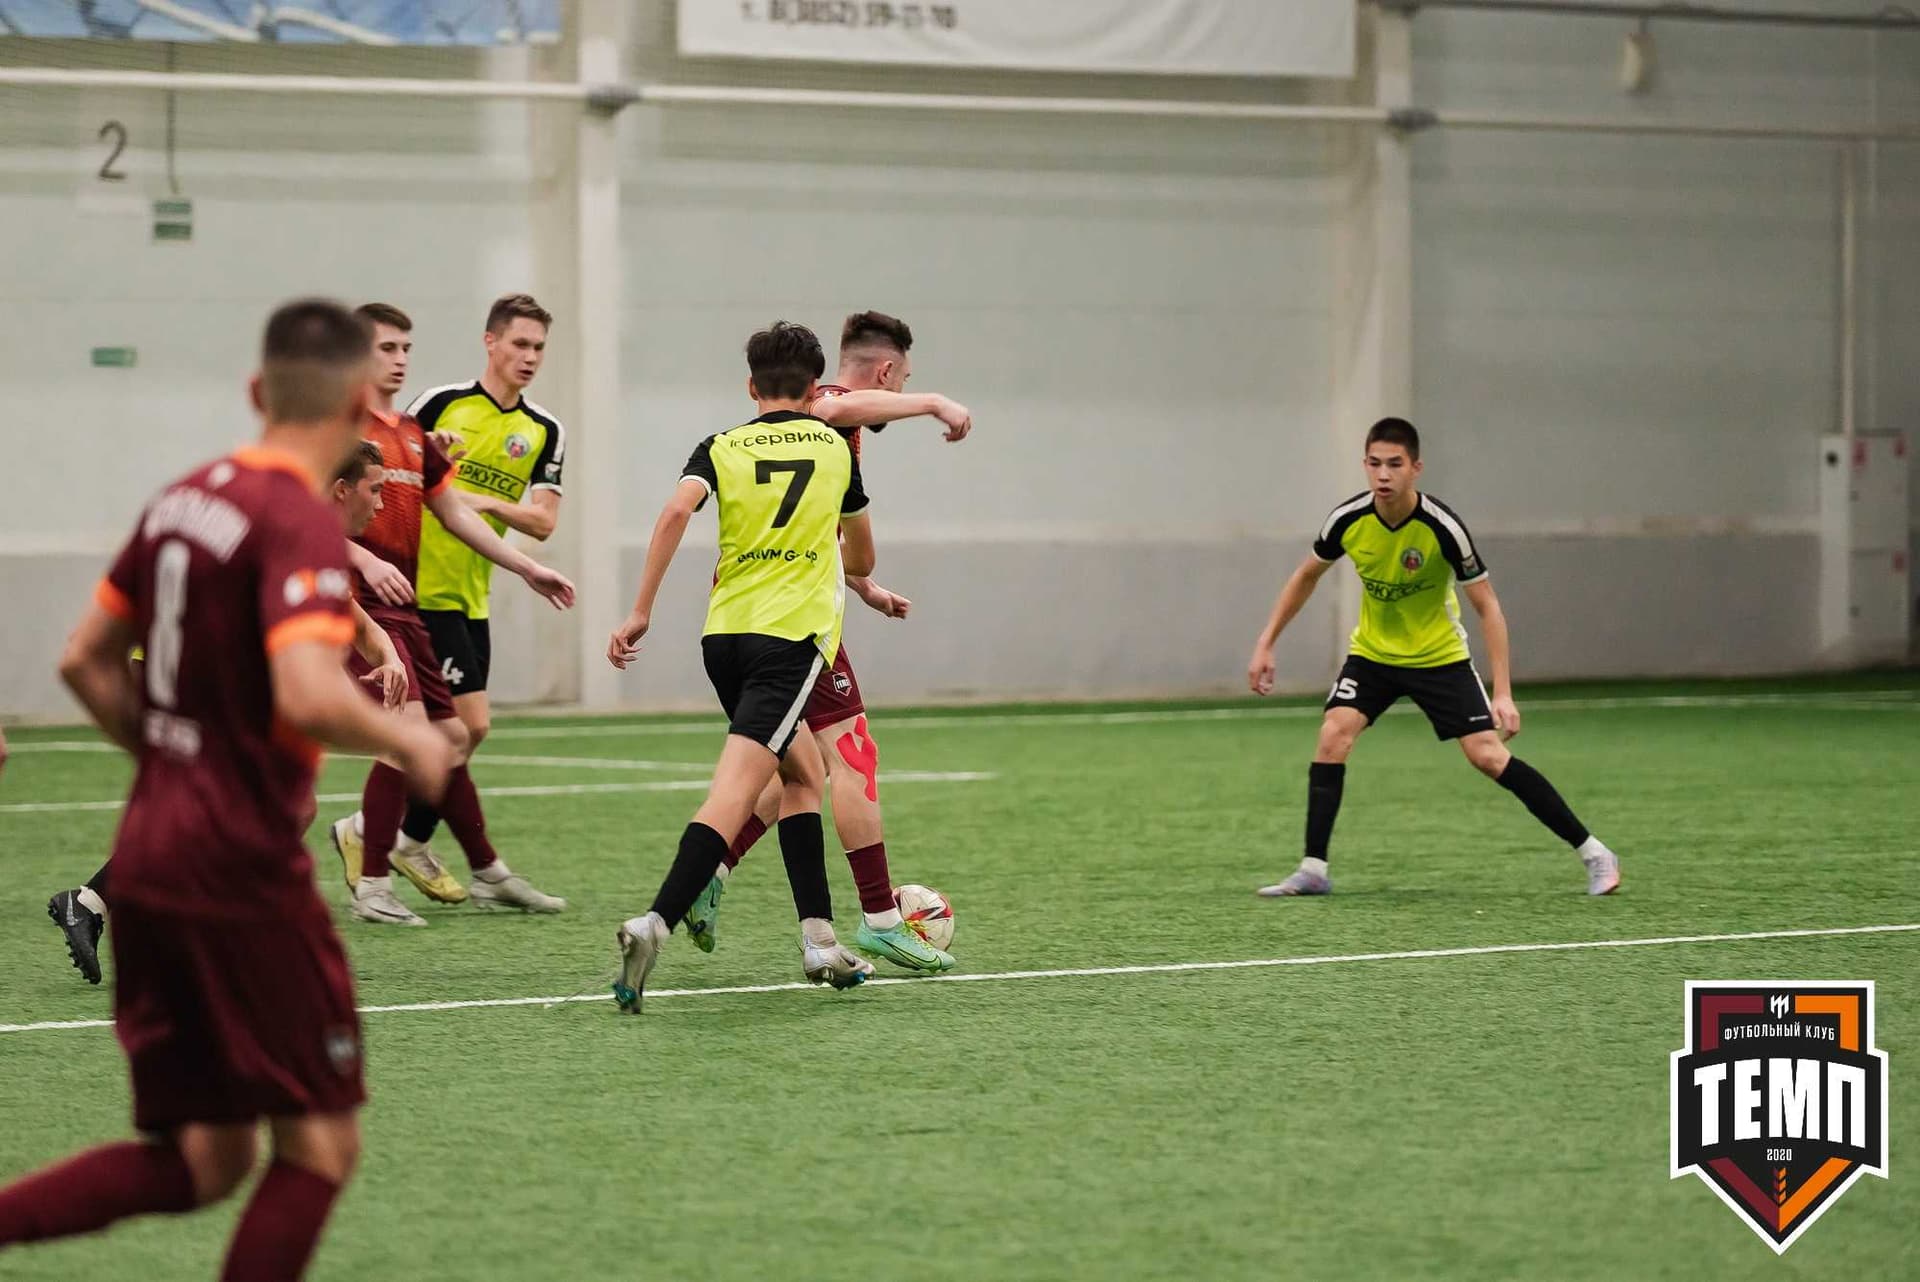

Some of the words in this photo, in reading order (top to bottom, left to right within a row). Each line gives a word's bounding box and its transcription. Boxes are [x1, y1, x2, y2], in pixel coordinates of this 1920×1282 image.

[98, 119, 127, 180] 2
[755, 459, 815, 528] 7
[1327, 678, 1359, 702] 5
